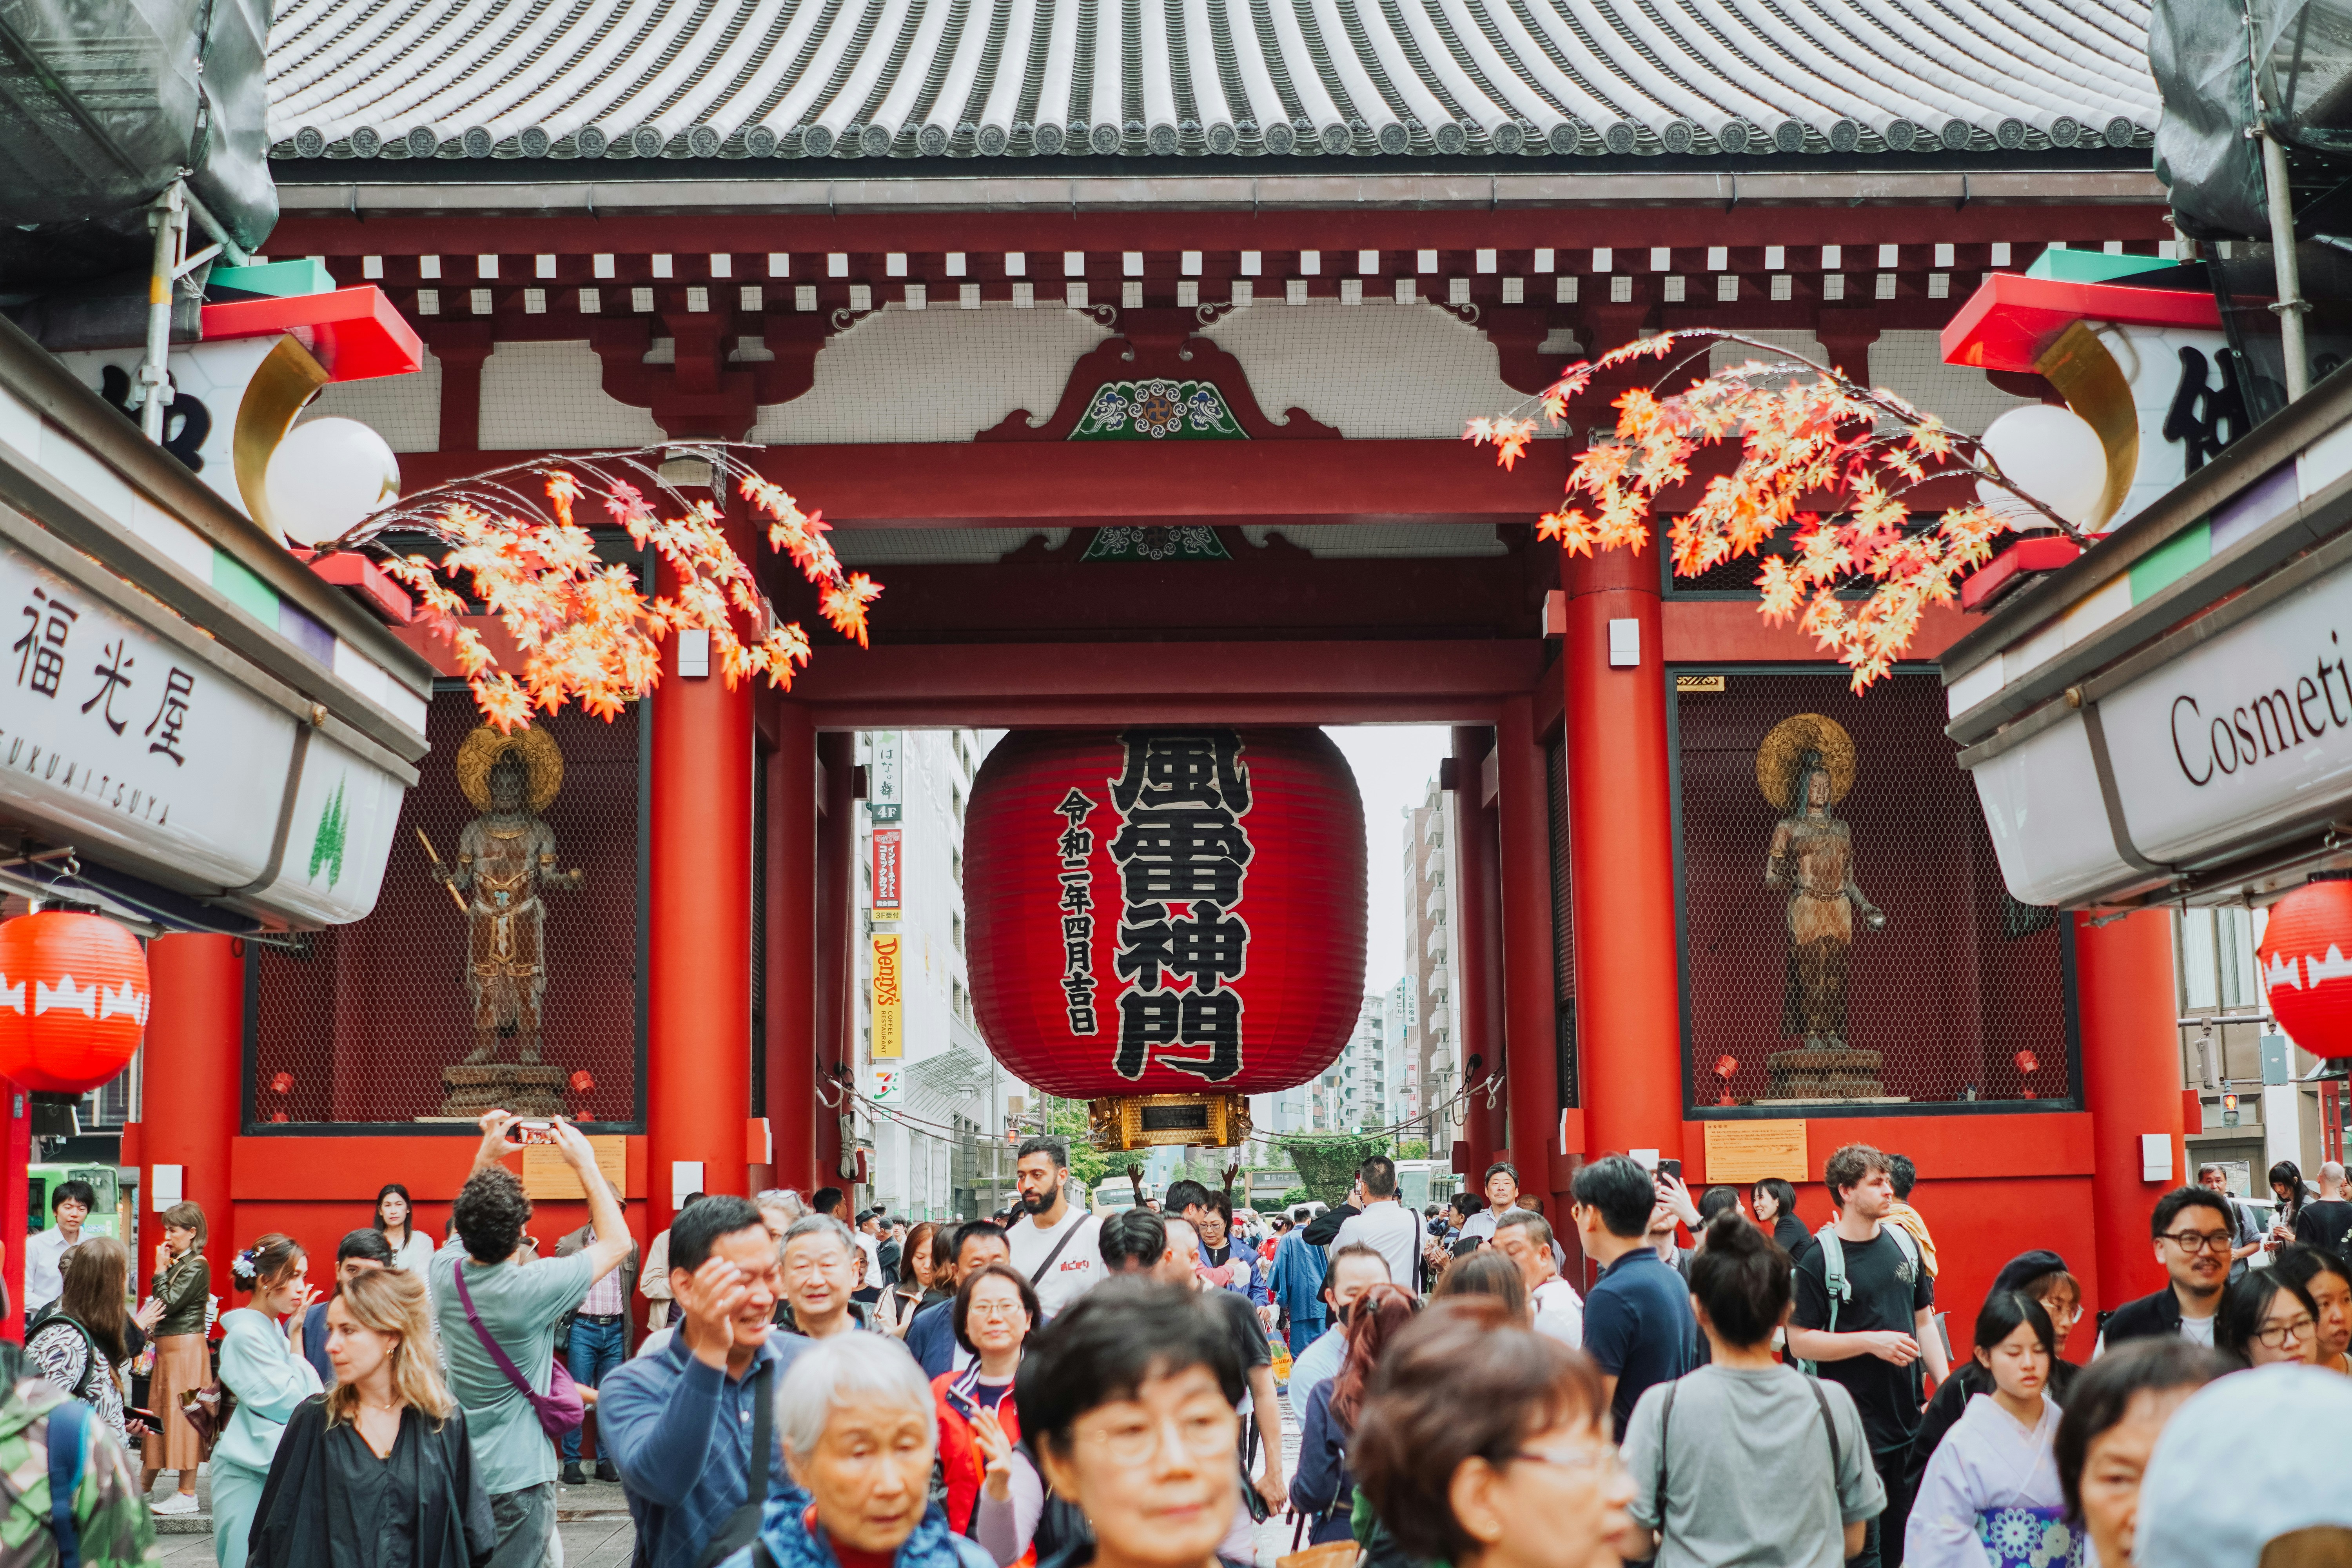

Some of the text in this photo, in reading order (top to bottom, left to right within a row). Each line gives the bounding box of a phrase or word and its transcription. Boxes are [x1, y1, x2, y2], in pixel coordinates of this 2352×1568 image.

[14, 587, 196, 767] 福光屋
[0, 729, 170, 826] UKUMITSUYA
[880, 749, 895, 800] はなの舞
[877, 806, 897, 818] 4F
[879, 846, 887, 898] コミックカフェ
[1109, 730, 1254, 1081] 風雷神門
[1054, 788, 1098, 1036] 令和二年四月吉日
[874, 938, 900, 1005] Denny's
[1408, 1064, 1417, 1117] 岡三証券
